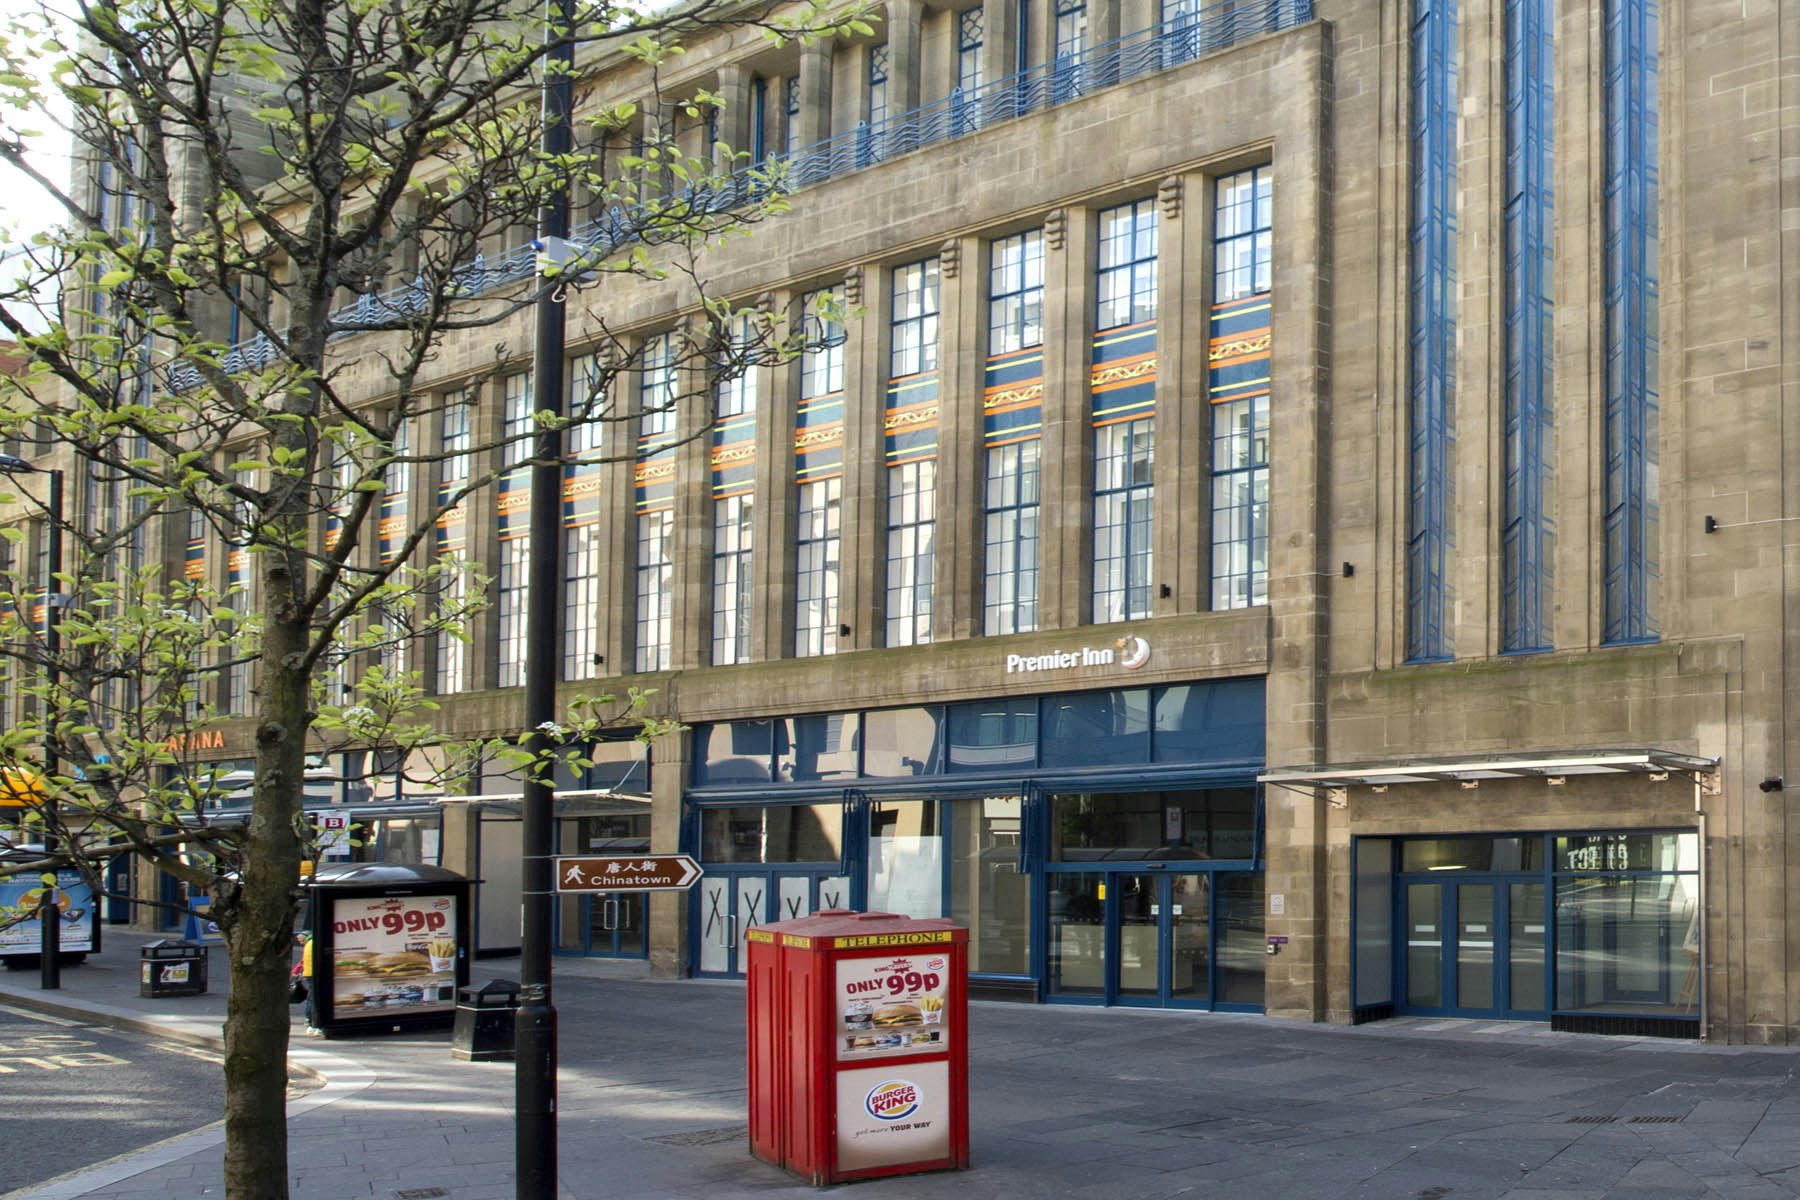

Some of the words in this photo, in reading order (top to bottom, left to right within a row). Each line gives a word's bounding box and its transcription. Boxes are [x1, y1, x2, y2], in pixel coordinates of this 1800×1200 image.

[1007, 650, 1082, 673] Premier
[1083, 648, 1114, 666] Inn
[605, 860, 658, 874] 唐人街
[590, 876, 671, 886] Chinatown
[333, 916, 380, 934] ONLY
[382, 910, 446, 935] 99p
[842, 932, 944, 947] TELEPHONE
[846, 978, 883, 994] ONLY
[886, 971, 940, 996] 99p
[872, 1086, 914, 1104] BURGER
[874, 1093, 916, 1114] KING
[890, 1124, 912, 1132] YOUR
[914, 1121, 931, 1129] WAY
